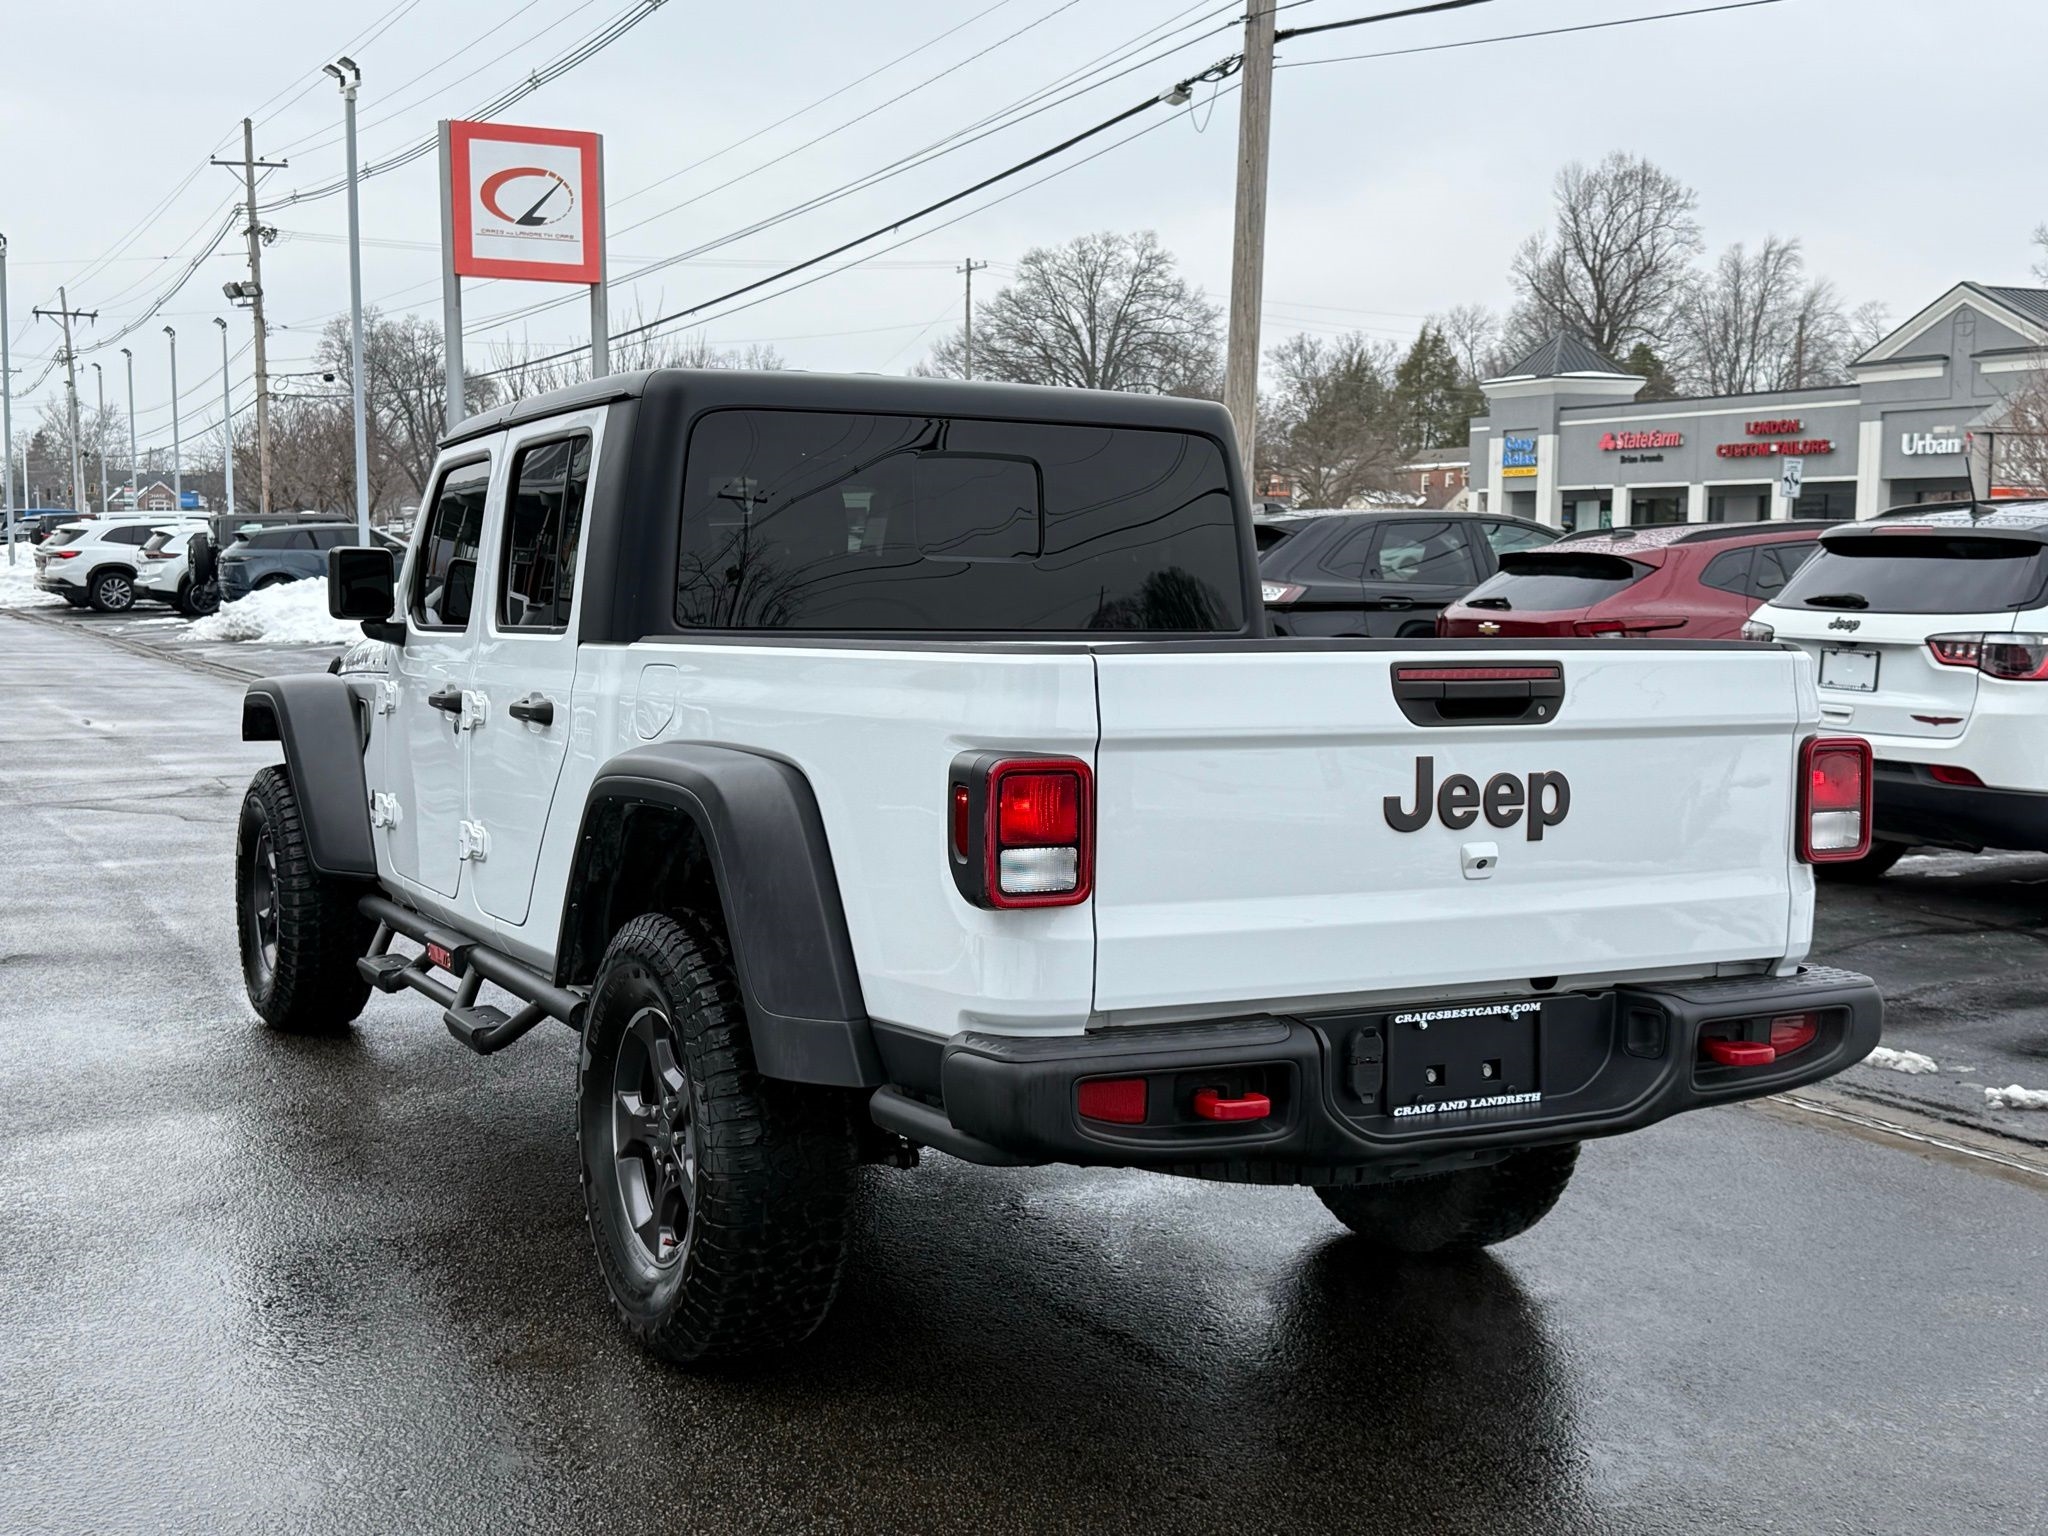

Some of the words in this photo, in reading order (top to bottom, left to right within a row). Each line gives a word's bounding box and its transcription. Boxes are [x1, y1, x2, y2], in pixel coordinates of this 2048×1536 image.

[1745, 419, 1800, 435] LONDON
[1717, 443, 1770, 458] CUSTOM
[1774, 439, 1831, 455] TAILORS
[1902, 432, 1961, 455] Urban
[1828, 616, 1860, 633] Jeep
[1383, 756, 1571, 842] Jeep
[1394, 1002, 1542, 1024] CRAIGSBESTCARS.COM
[1393, 1104, 1436, 1117] CRAIG
[1438, 1100, 1468, 1112] AND
[1470, 1092, 1542, 1109] LANDRETH
